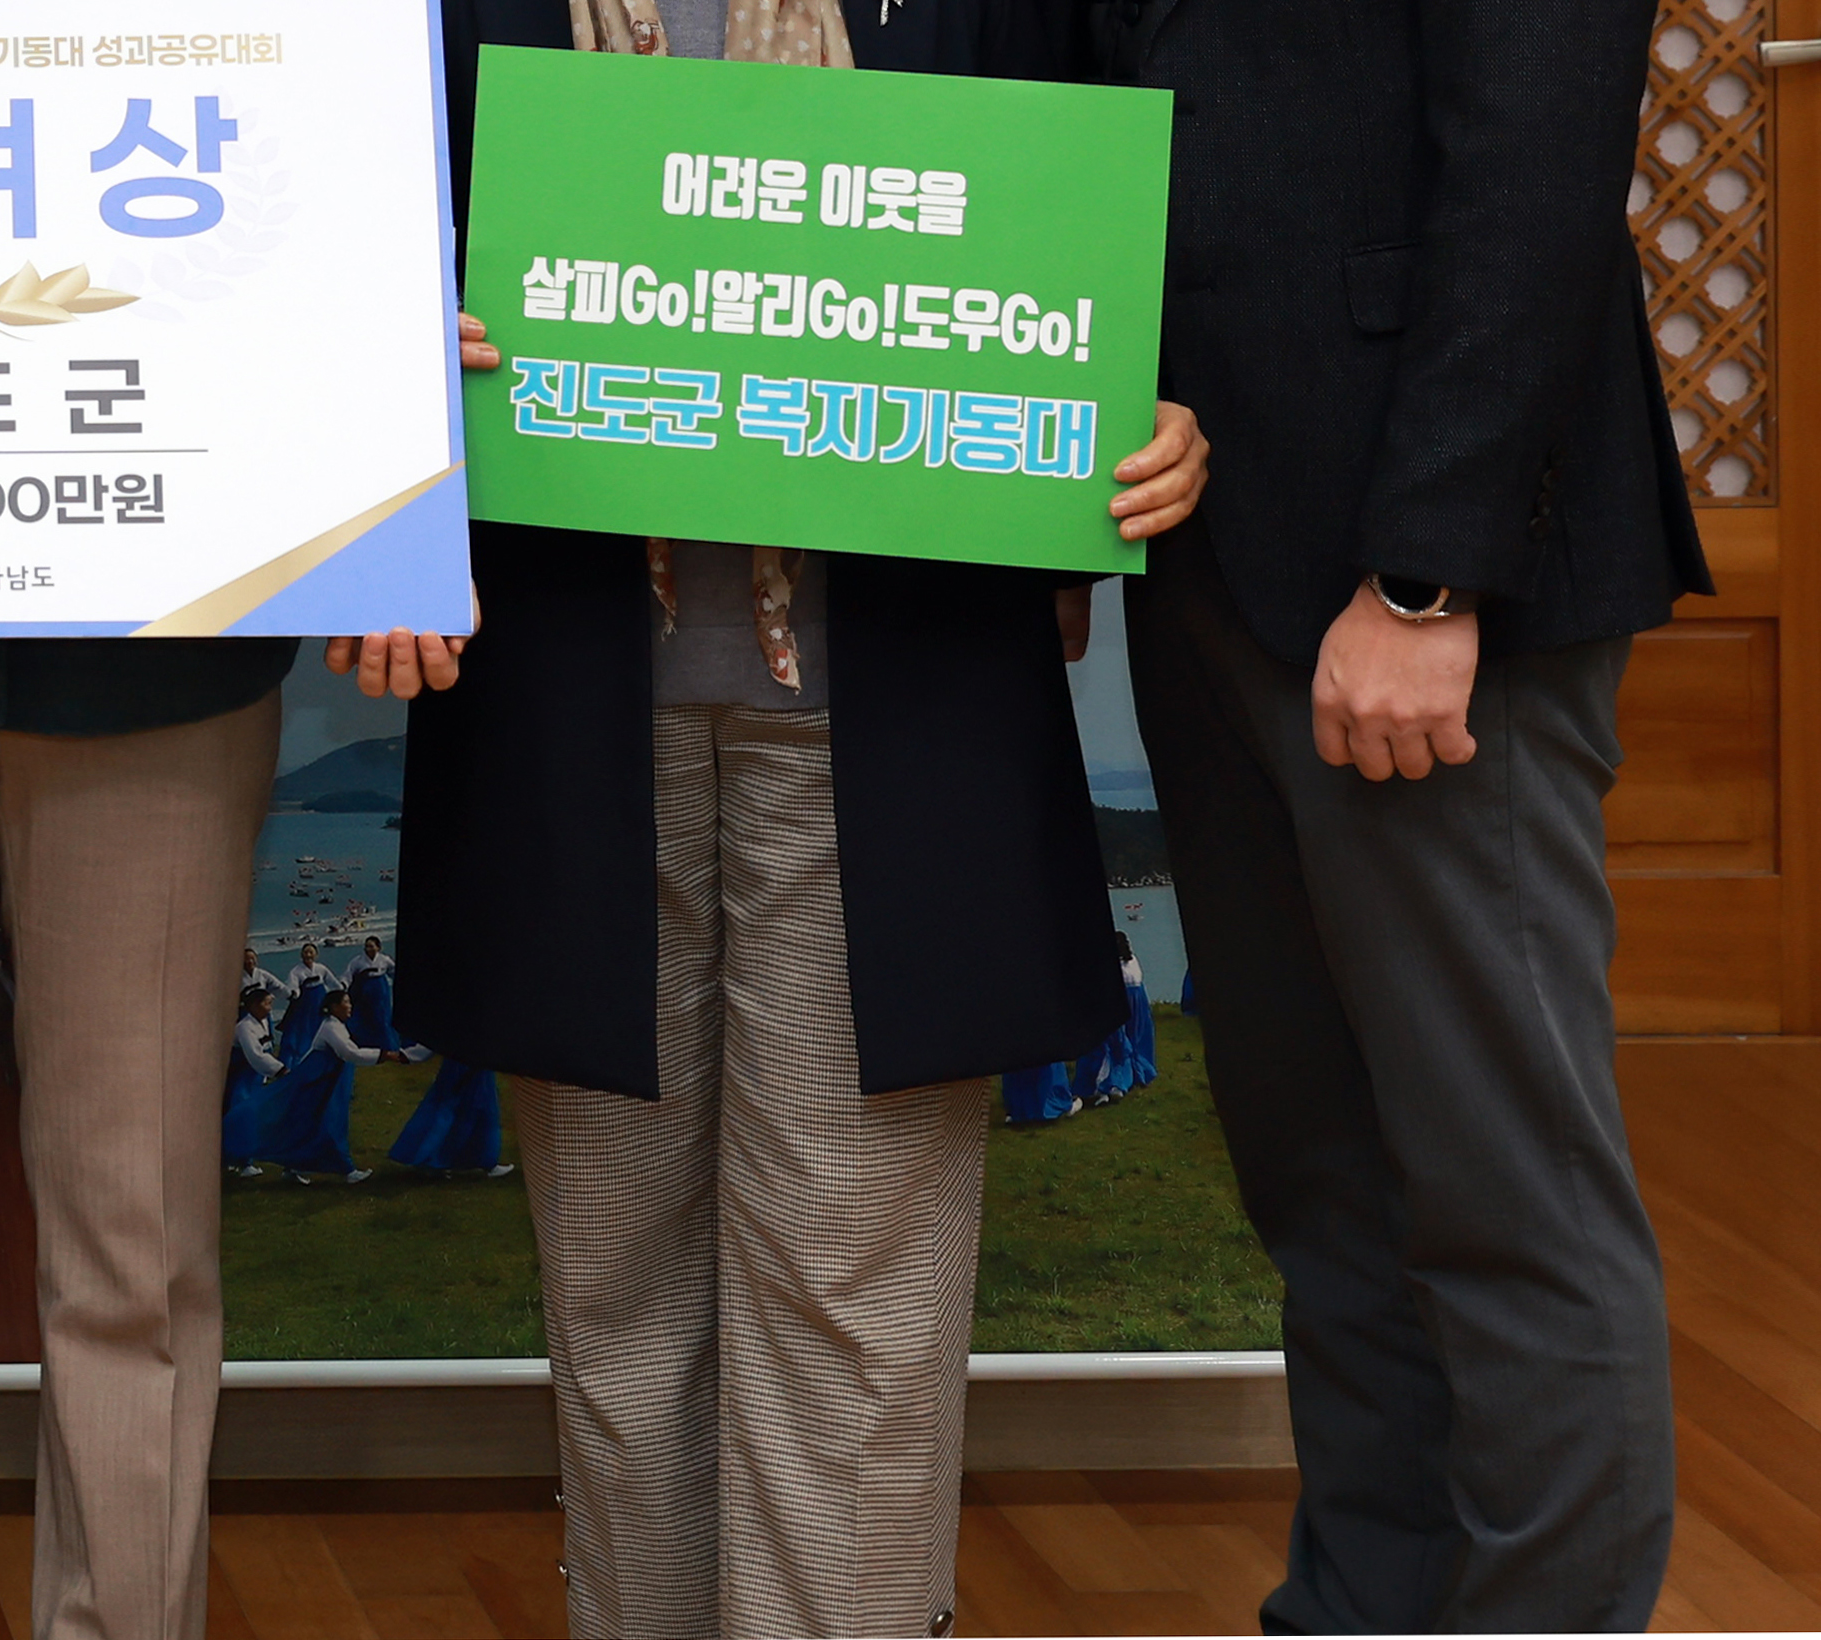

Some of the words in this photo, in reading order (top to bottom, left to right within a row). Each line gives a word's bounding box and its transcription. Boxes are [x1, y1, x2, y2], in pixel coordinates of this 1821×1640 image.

[92, 33, 283, 69] 성과공유대회
[662, 152, 807, 224] 어려운
[820, 163, 967, 236] 이웃을
[510, 356, 723, 450] 진도군
[736, 375, 1097, 479] 복지기동대
